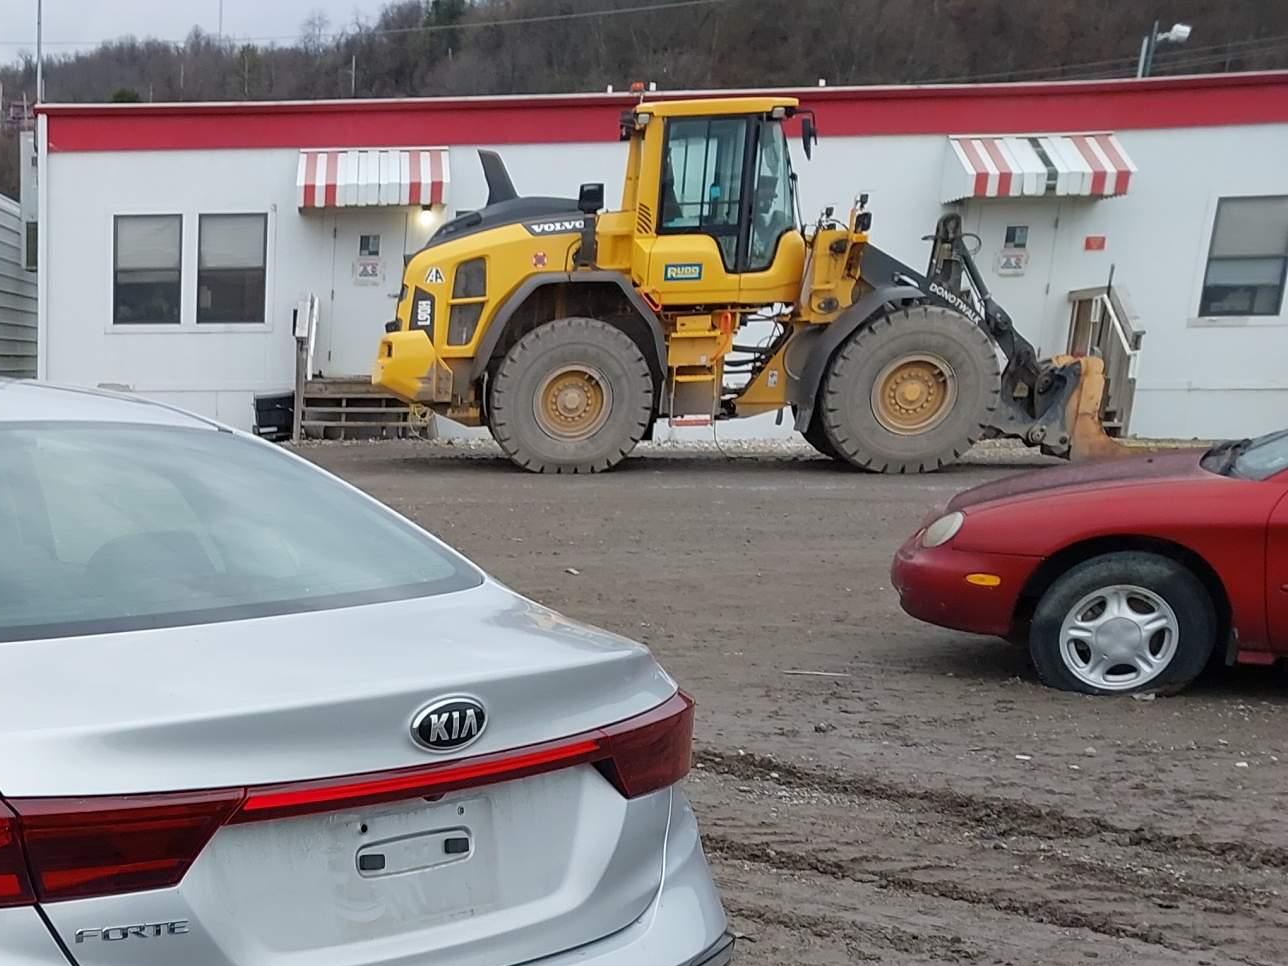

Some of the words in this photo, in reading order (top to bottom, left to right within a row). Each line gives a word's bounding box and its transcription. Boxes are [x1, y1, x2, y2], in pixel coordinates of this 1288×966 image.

[530, 220, 584, 233] VOLVO
[430, 708, 478, 742] KIA
[75, 919, 190, 944] FORTE
